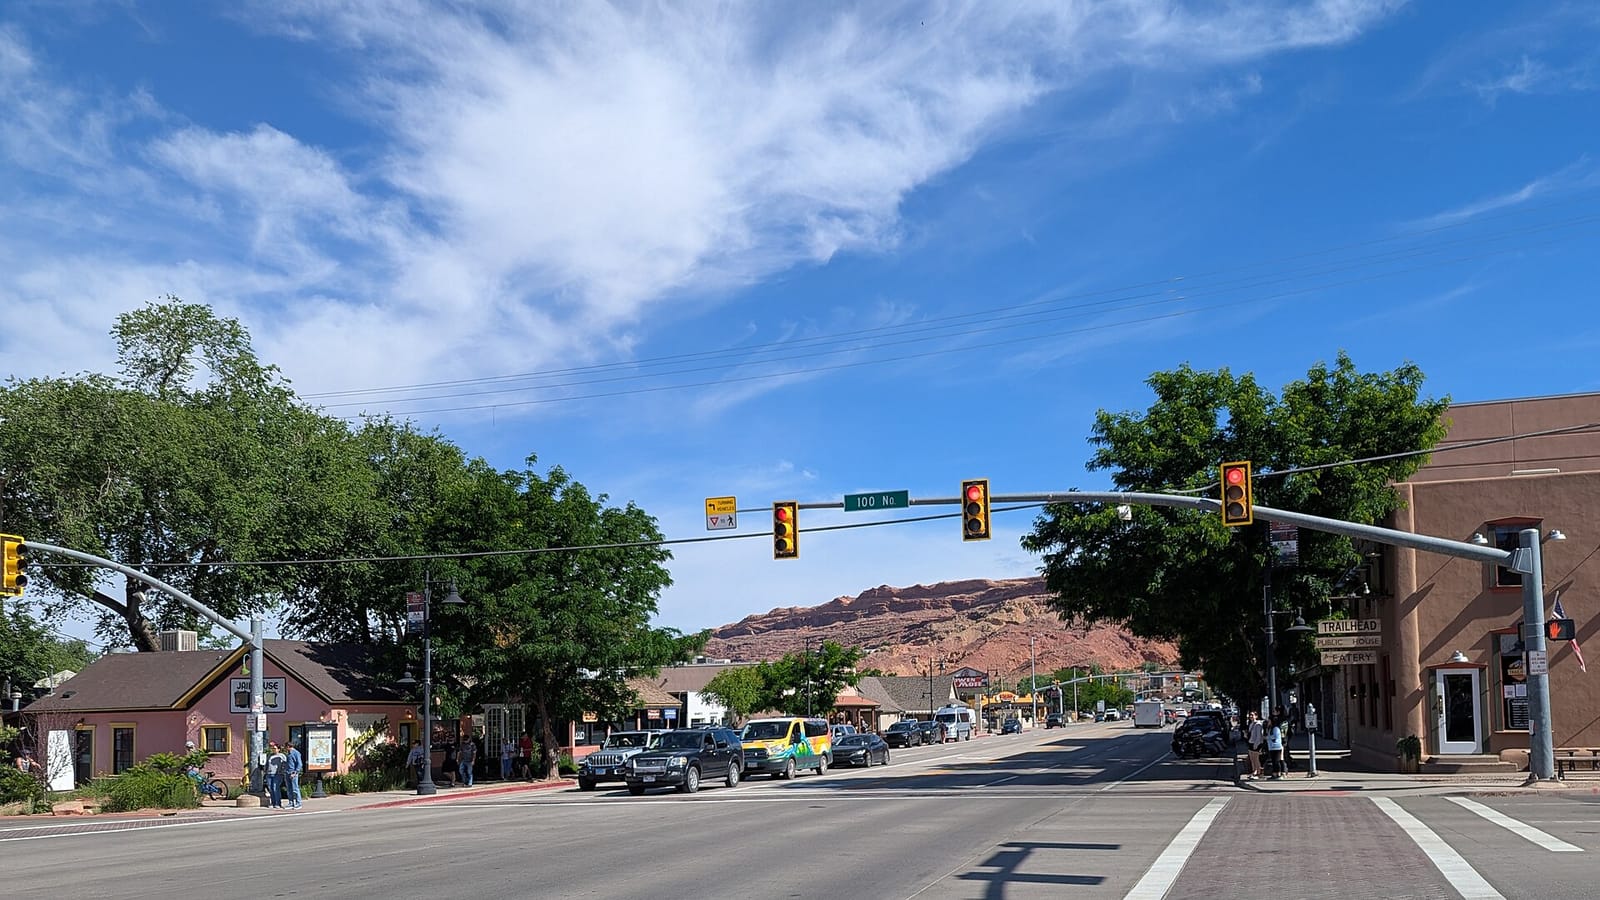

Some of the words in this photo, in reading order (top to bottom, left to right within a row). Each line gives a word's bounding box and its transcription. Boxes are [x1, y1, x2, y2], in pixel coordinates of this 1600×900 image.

[857, 496, 875, 508] 100
[882, 495, 897, 506] No.
[1322, 620, 1377, 632] TRAILHEAD
[1317, 639, 1344, 647] PUBLIC
[1352, 637, 1380, 646] HOUSE
[1332, 653, 1372, 663] EATERY
